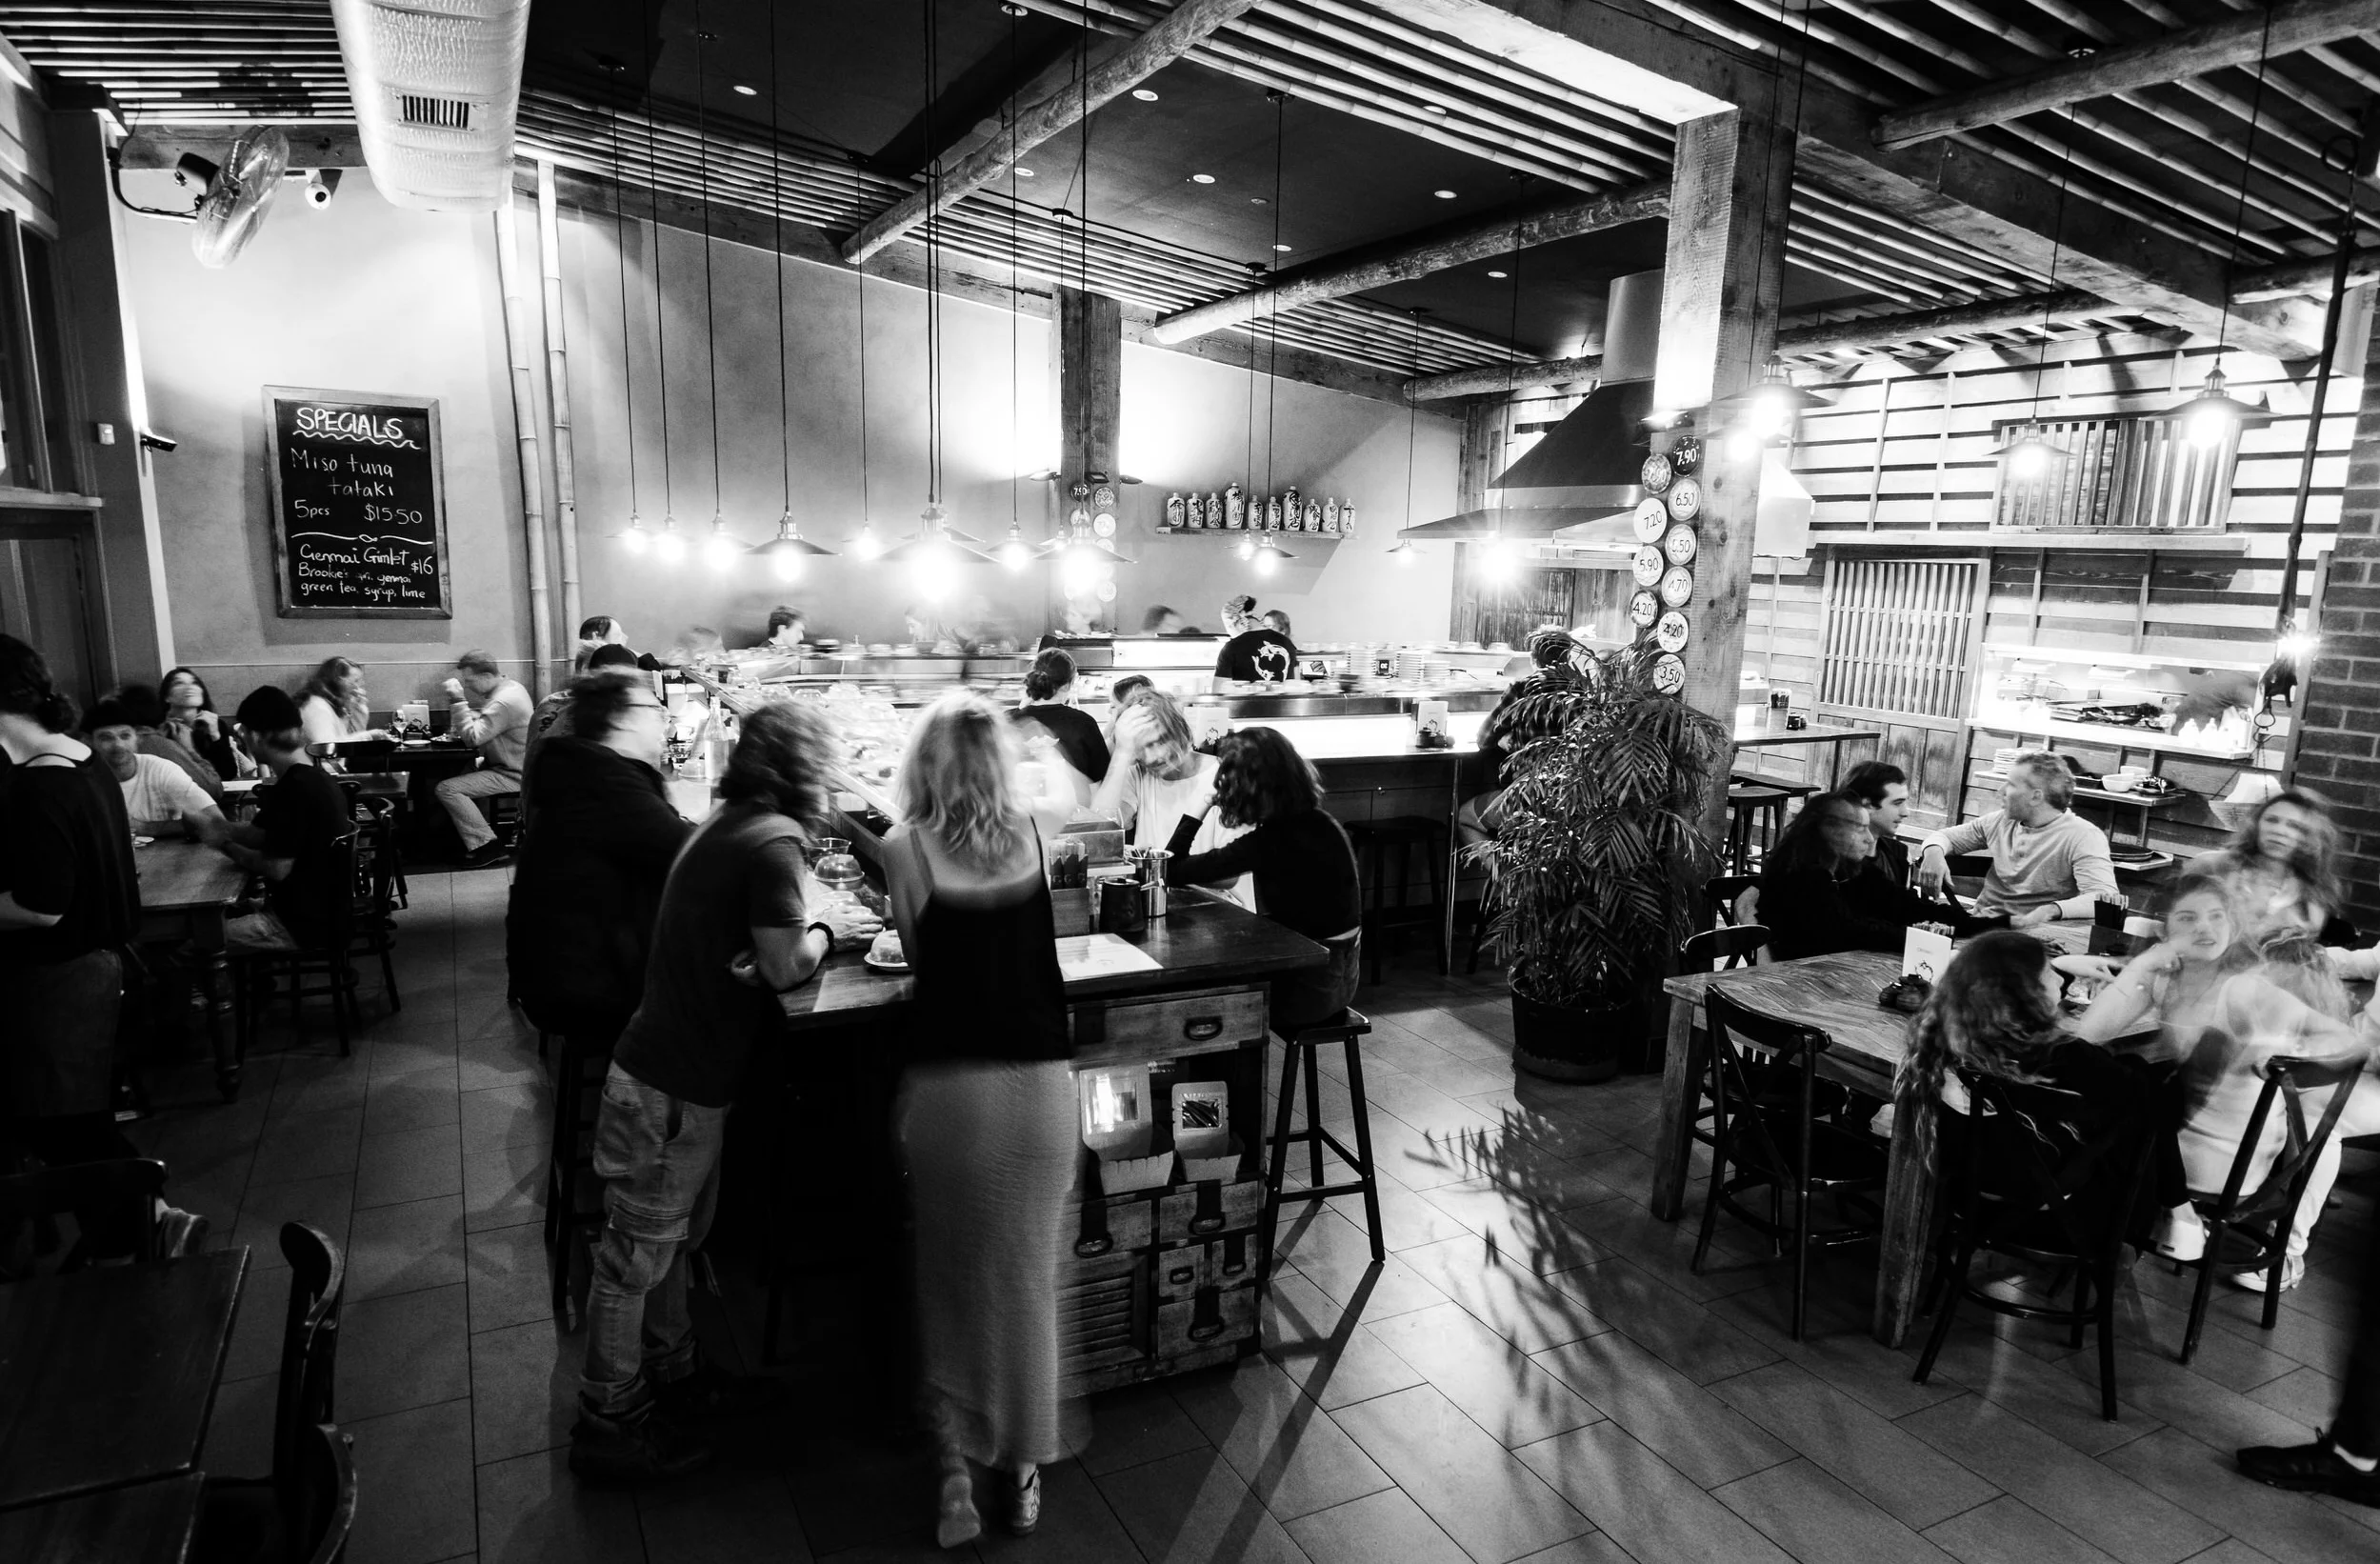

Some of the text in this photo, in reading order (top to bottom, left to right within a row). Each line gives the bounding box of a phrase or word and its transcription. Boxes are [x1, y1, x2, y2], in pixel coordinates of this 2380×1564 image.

[296, 407, 404, 440] SPECIALS
[290, 447, 393, 478] Miso tuna
[1675, 448, 1697, 466] 7.90
[328, 476, 394, 497] tataki
[1675, 492, 1695, 507] 6.50
[1644, 510, 1663, 530] 7.20
[300, 543, 433, 575] Genmai Gimlet $16
[1639, 557, 1659, 572] 5.90
[301, 582, 334, 596] green
[401, 584, 426, 599] lime
[1632, 601, 1652, 616] 4.20
[1660, 666, 1681, 683] 3.50
